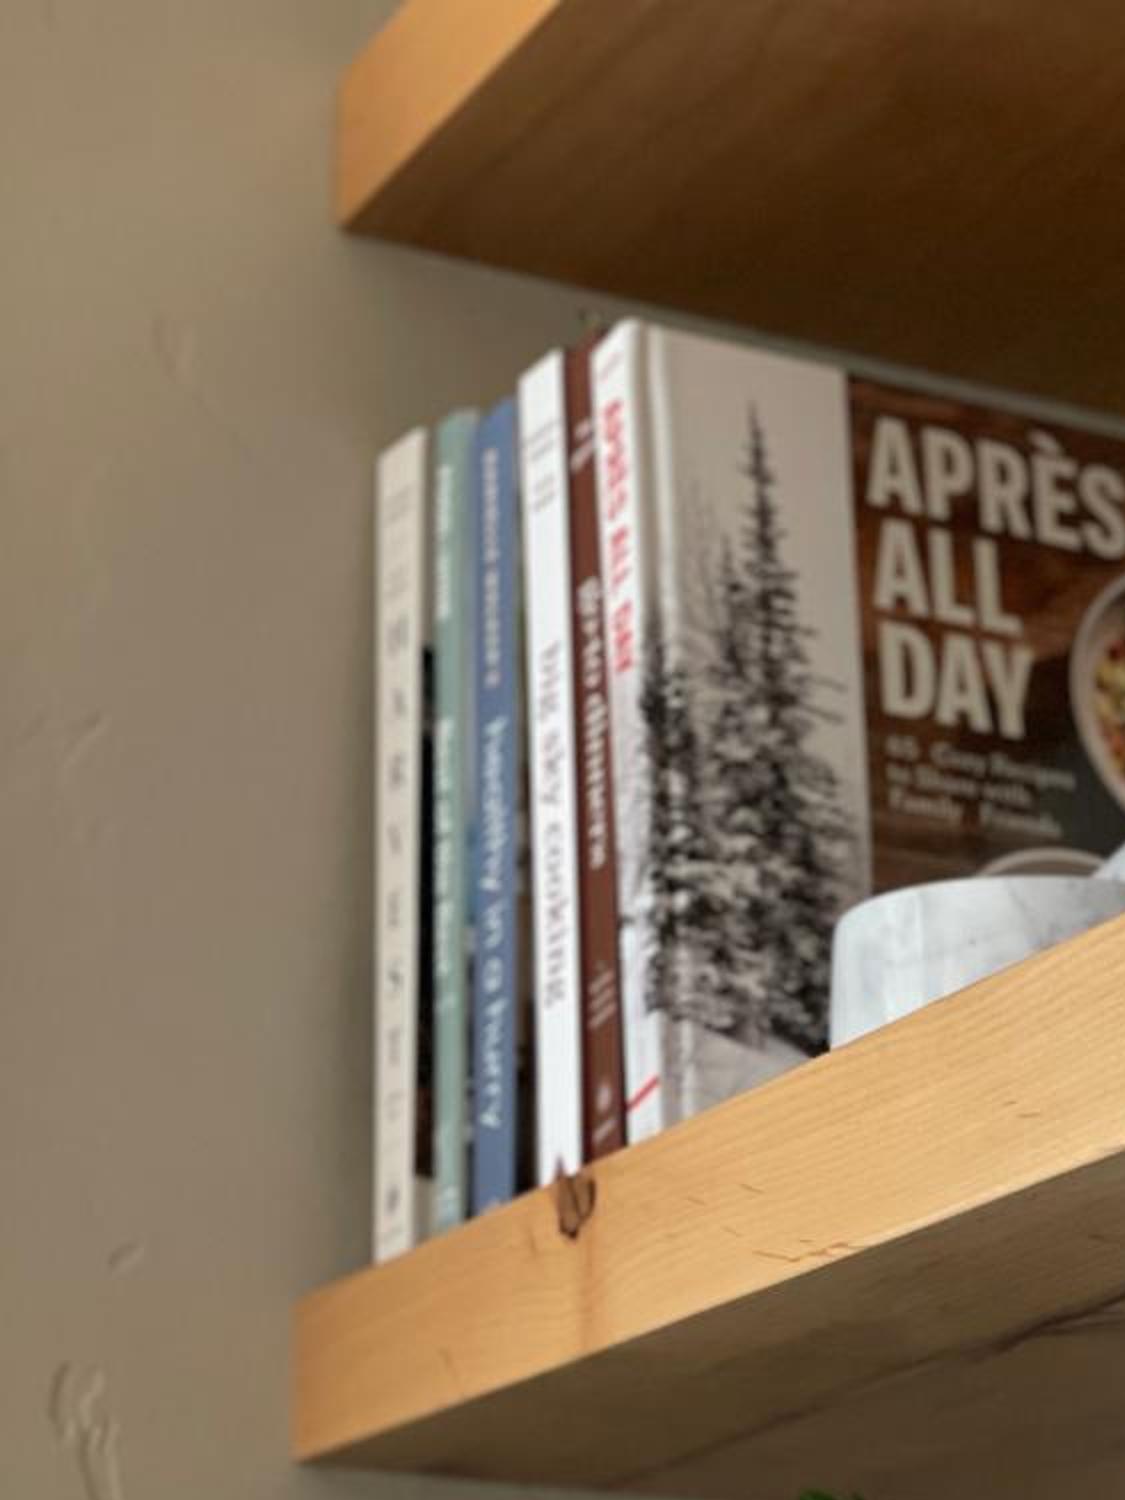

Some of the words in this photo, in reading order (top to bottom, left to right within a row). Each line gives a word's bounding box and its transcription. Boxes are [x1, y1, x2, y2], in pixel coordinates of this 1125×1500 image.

[872, 518, 1023, 639] ALL
[878, 622, 1033, 741] DAY
[543, 820, 569, 1009] cooking
[480, 998, 508, 1129] hurry
